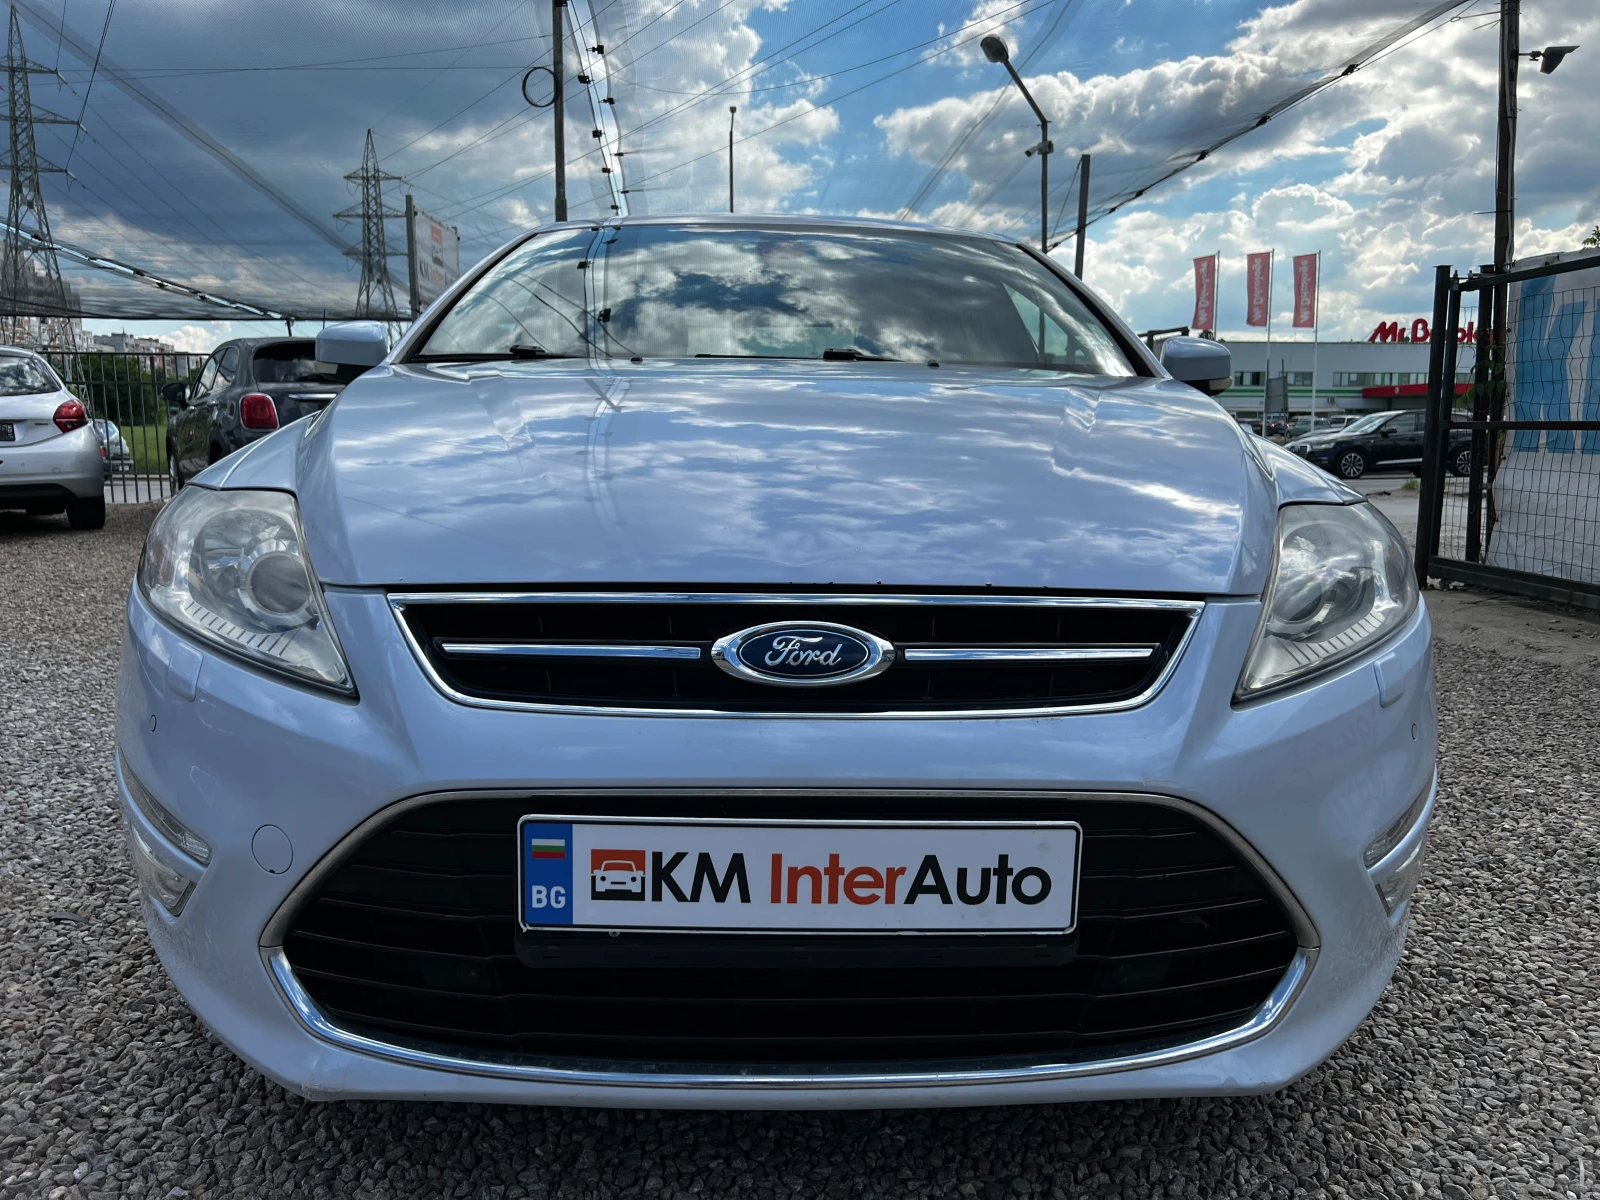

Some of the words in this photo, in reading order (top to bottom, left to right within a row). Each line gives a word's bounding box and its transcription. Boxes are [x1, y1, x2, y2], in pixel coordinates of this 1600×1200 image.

[764, 635, 843, 667] Ford
[650, 851, 752, 904] KM
[769, 853, 1053, 906] InterAuto
[531, 884, 567, 909] BG
